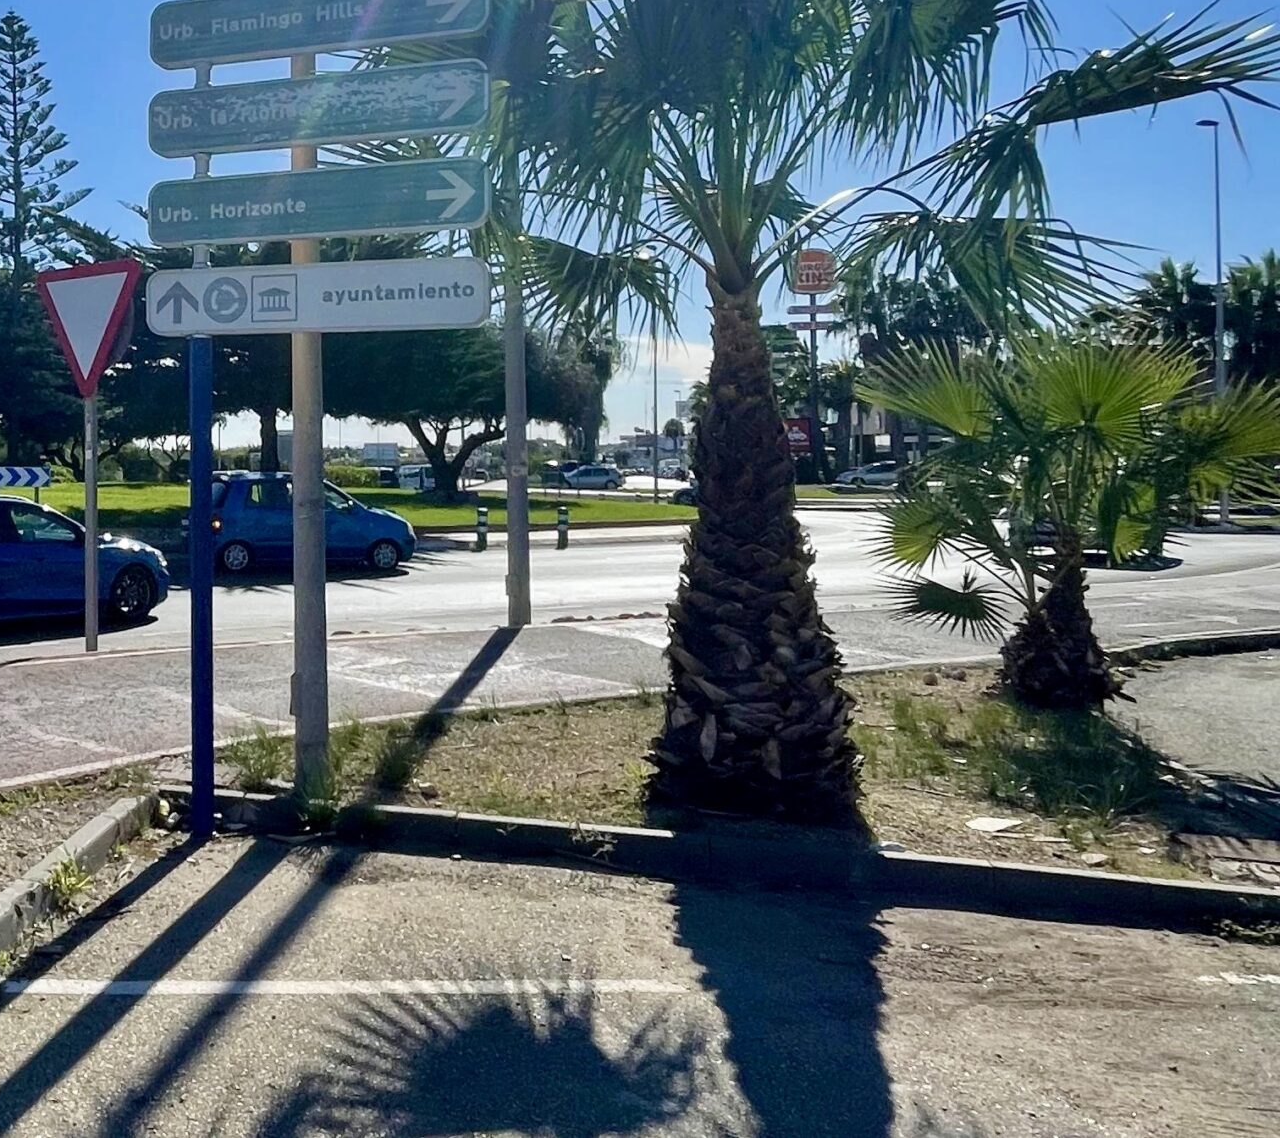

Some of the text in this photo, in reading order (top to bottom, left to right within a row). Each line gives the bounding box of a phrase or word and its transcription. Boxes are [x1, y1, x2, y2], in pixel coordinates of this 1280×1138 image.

[159, 2, 364, 41] Urb. Flamingo Hills
[158, 197, 307, 223] Urb. Horizonte
[322, 281, 475, 307] ayuntamiento
